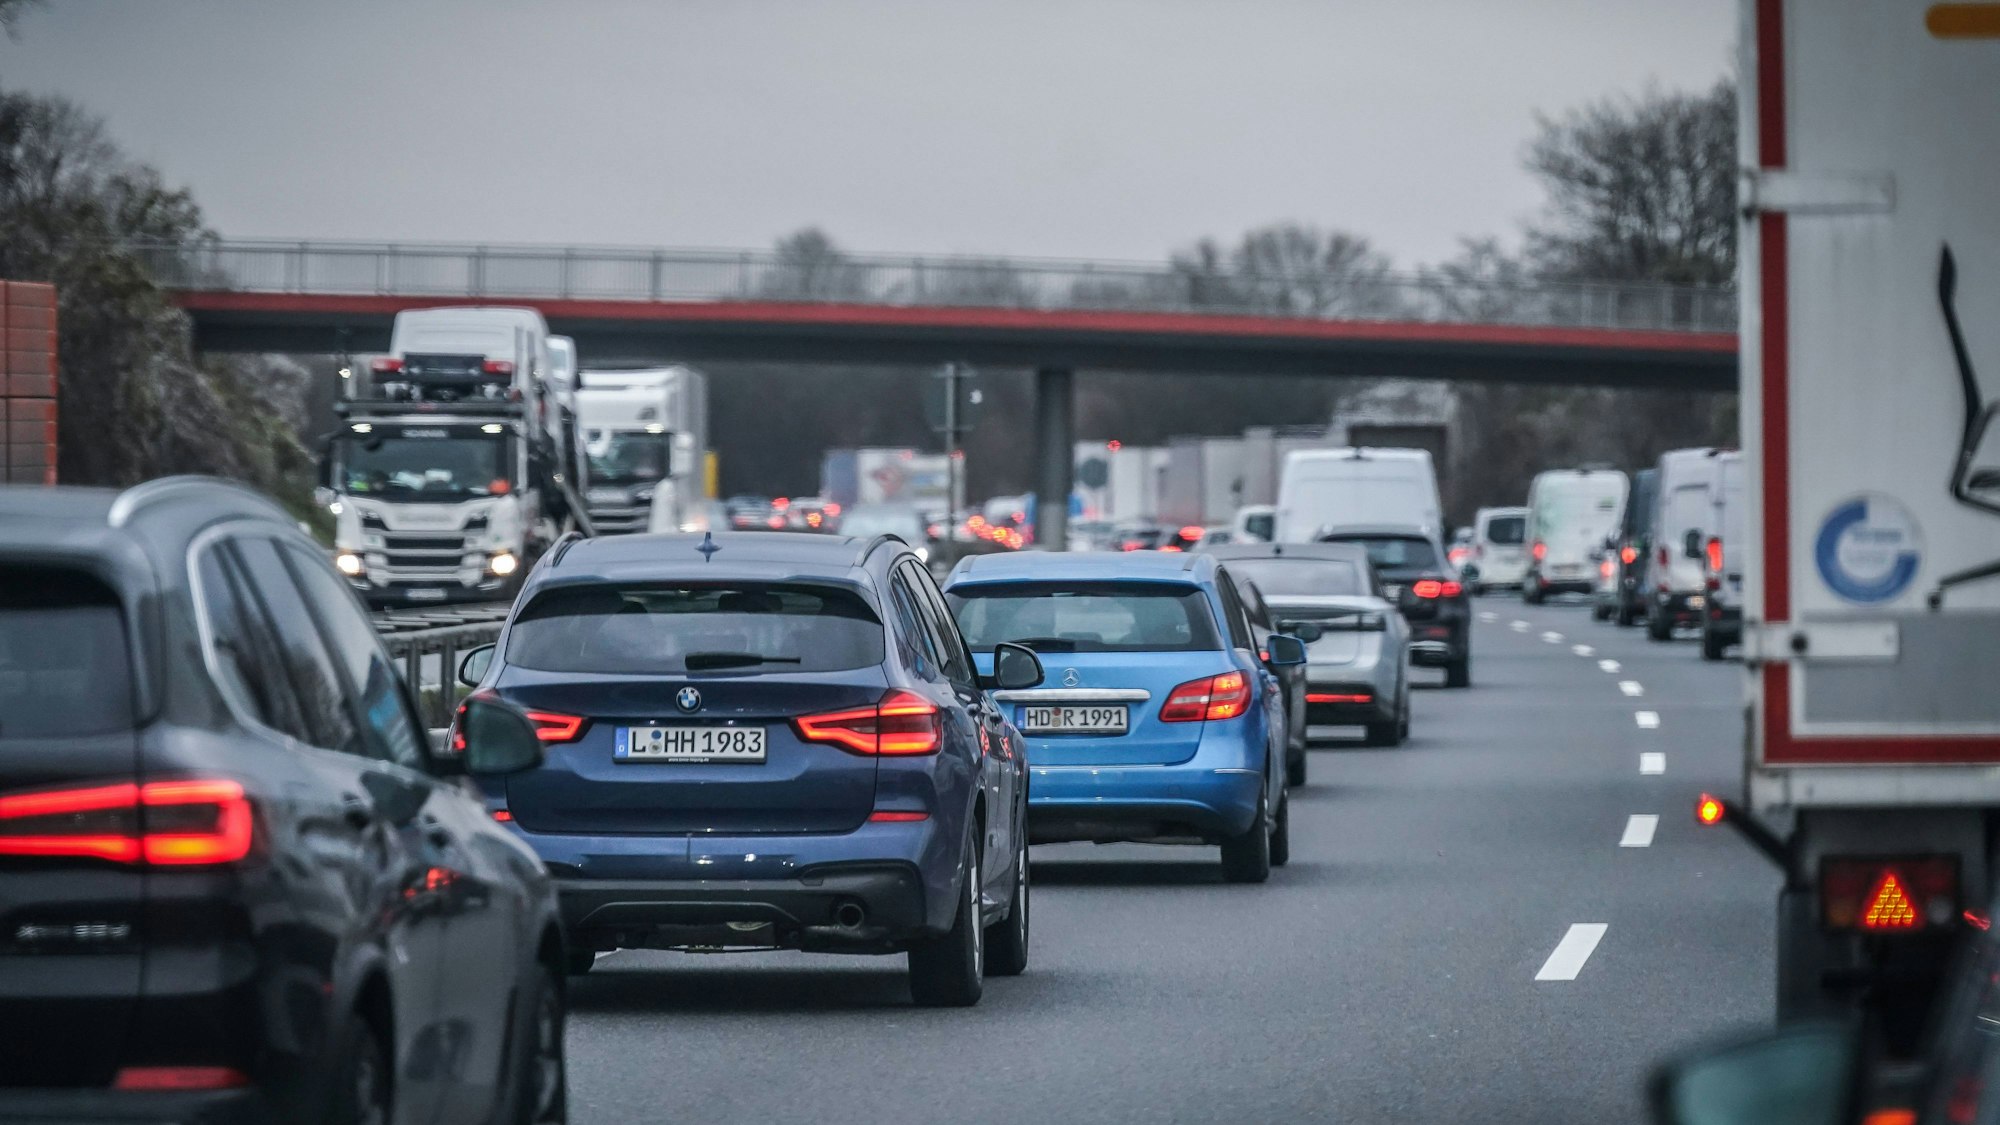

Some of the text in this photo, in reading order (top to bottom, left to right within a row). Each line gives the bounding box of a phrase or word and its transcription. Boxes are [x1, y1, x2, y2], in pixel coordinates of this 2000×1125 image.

[1027, 709, 1050, 726] HD
[1063, 709, 1074, 726] R
[1079, 709, 1124, 726] 1991
[631, 731, 762, 753] L HH 1983
